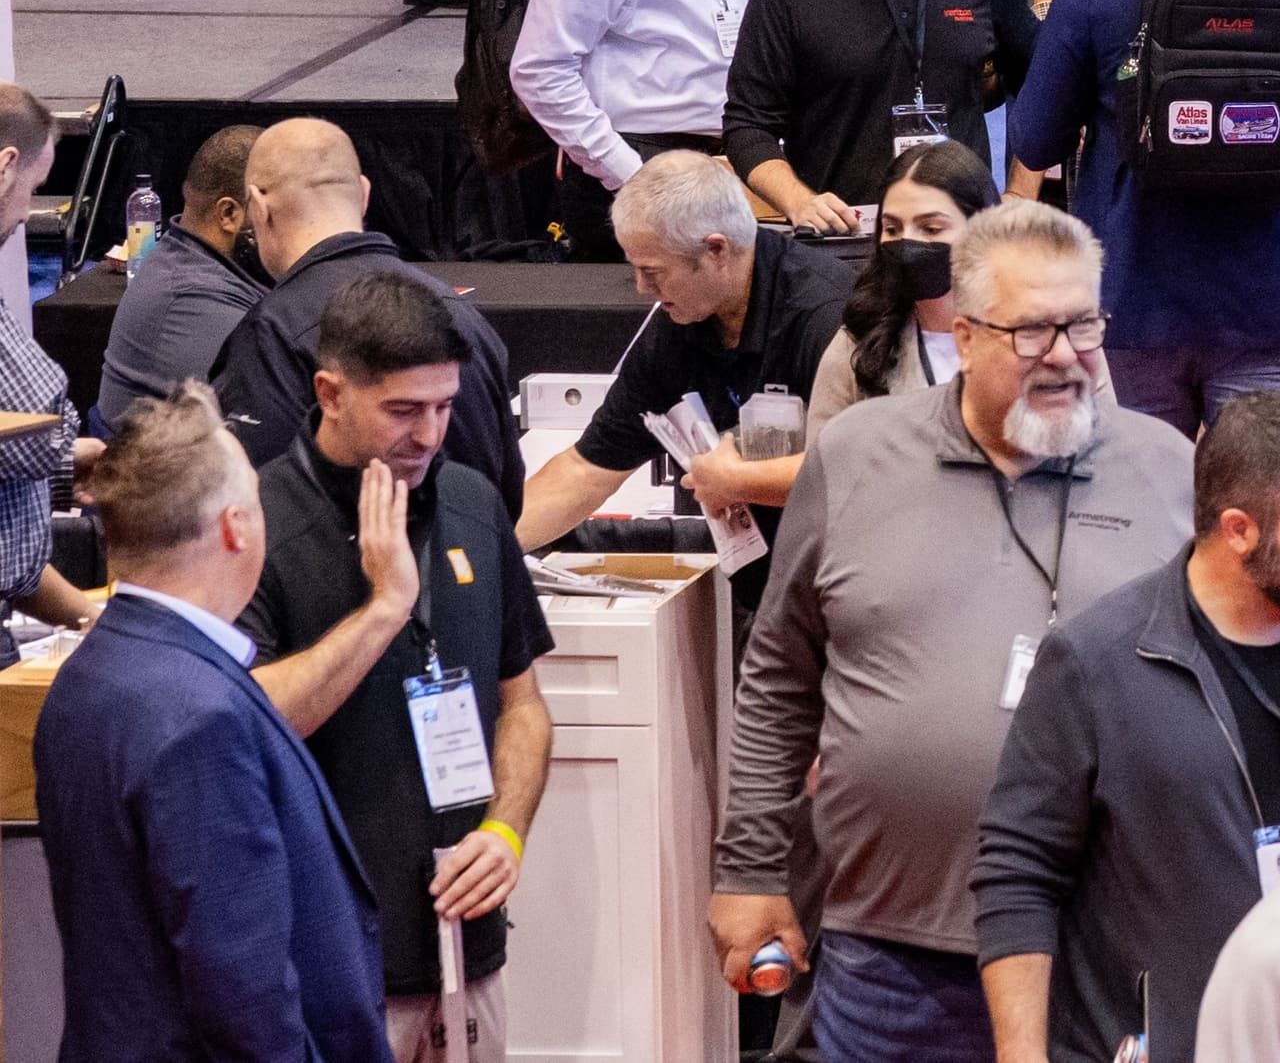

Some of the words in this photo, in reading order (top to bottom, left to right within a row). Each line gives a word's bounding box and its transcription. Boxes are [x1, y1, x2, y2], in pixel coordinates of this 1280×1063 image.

[1205, 17, 1255, 29] ATLAS
[1176, 106, 1208, 119] Atlas
[1068, 511, 1133, 528] Armstrong
